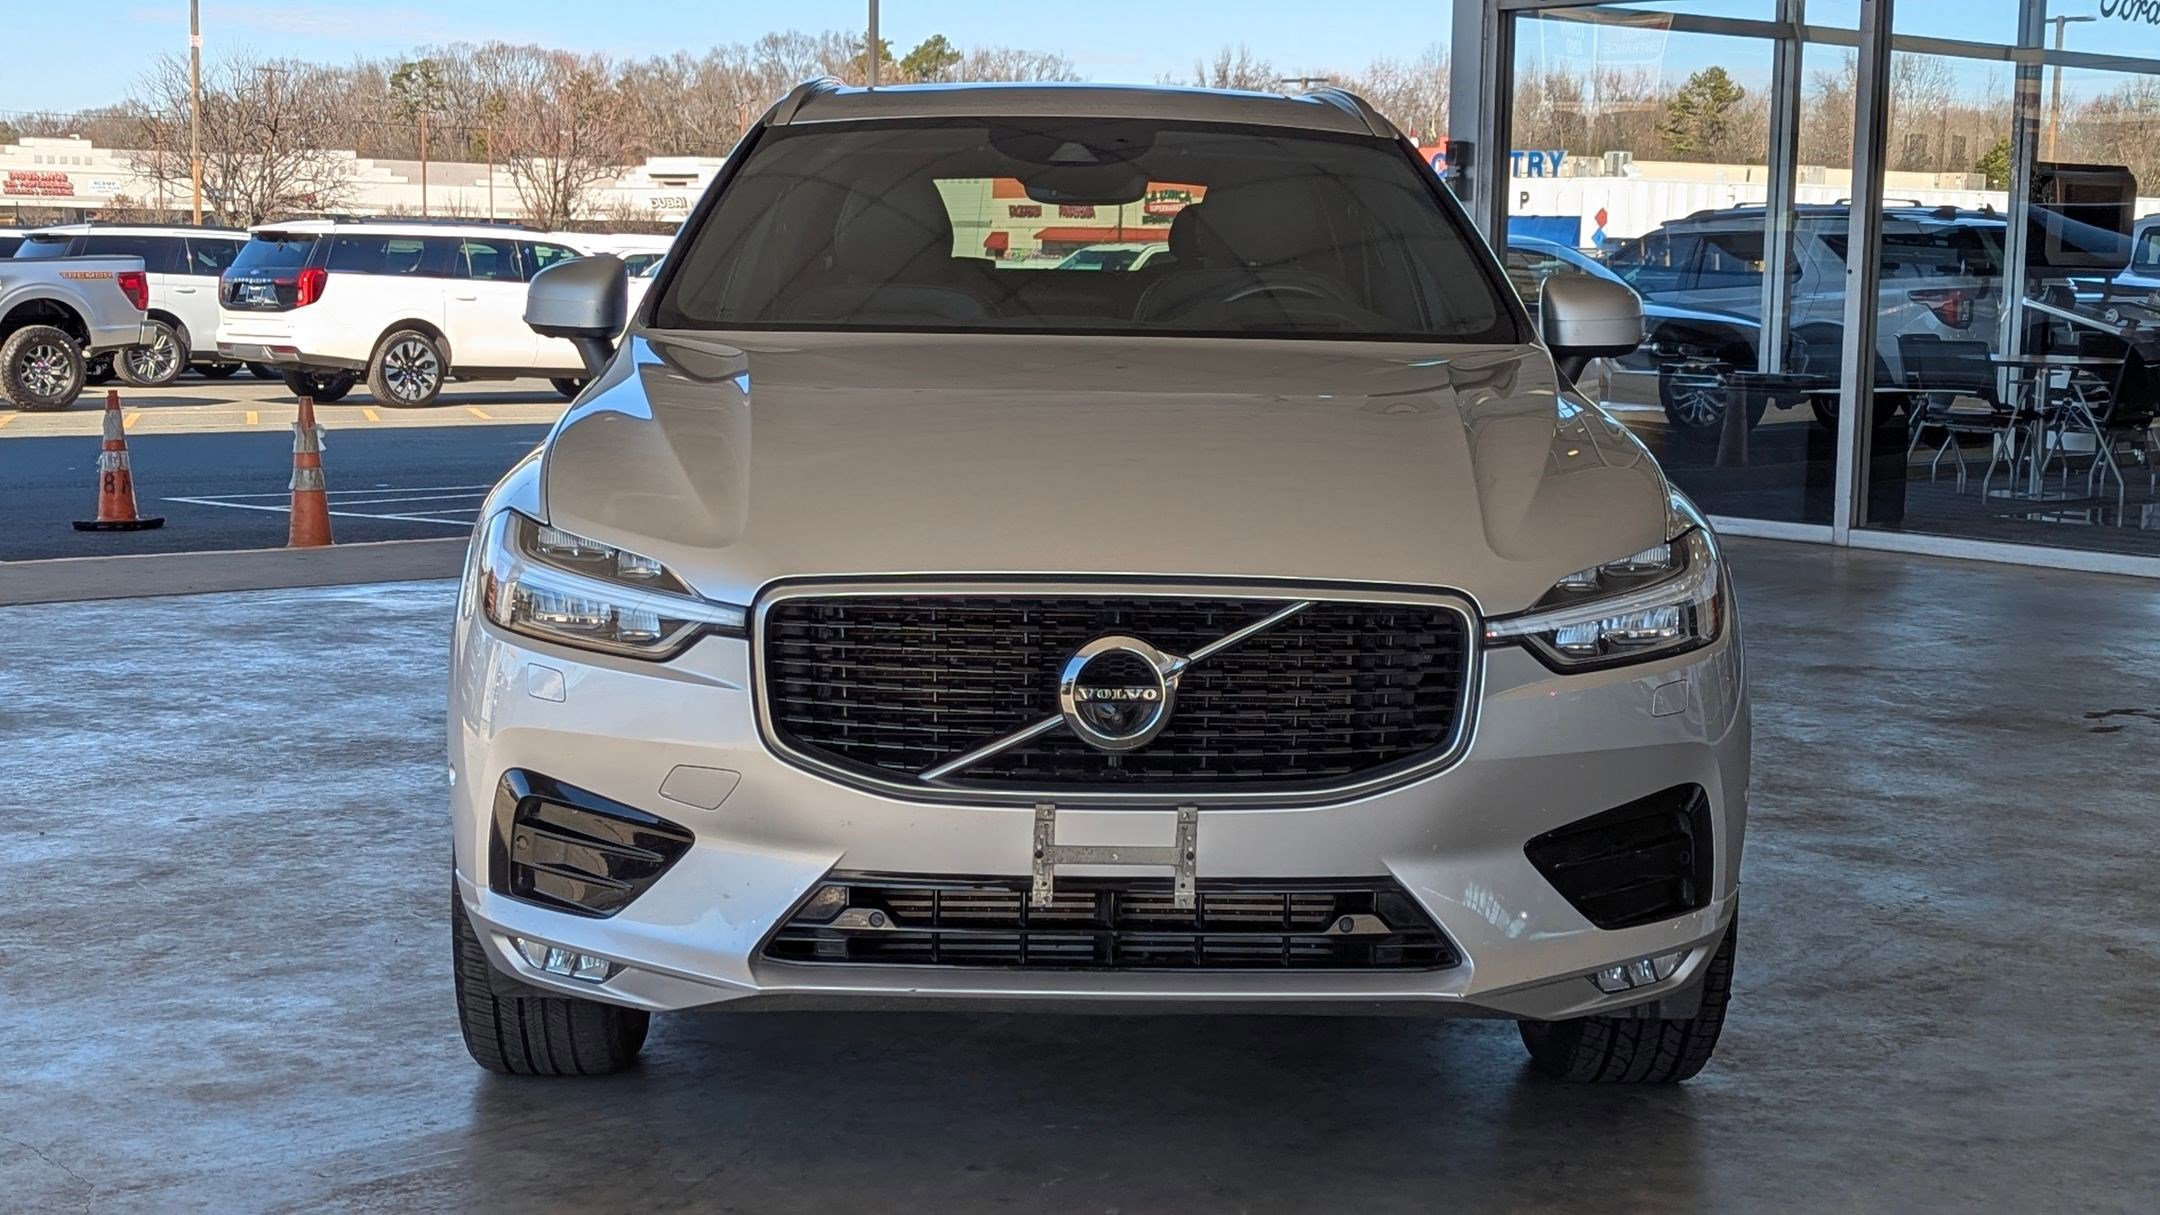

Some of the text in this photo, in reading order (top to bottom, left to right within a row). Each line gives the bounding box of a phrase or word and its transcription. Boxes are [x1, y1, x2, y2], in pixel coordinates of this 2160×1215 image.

[650, 196, 688, 209] DUBAI
[59, 271, 113, 280] TREMOR
[1078, 688, 1157, 700] VOLVO
